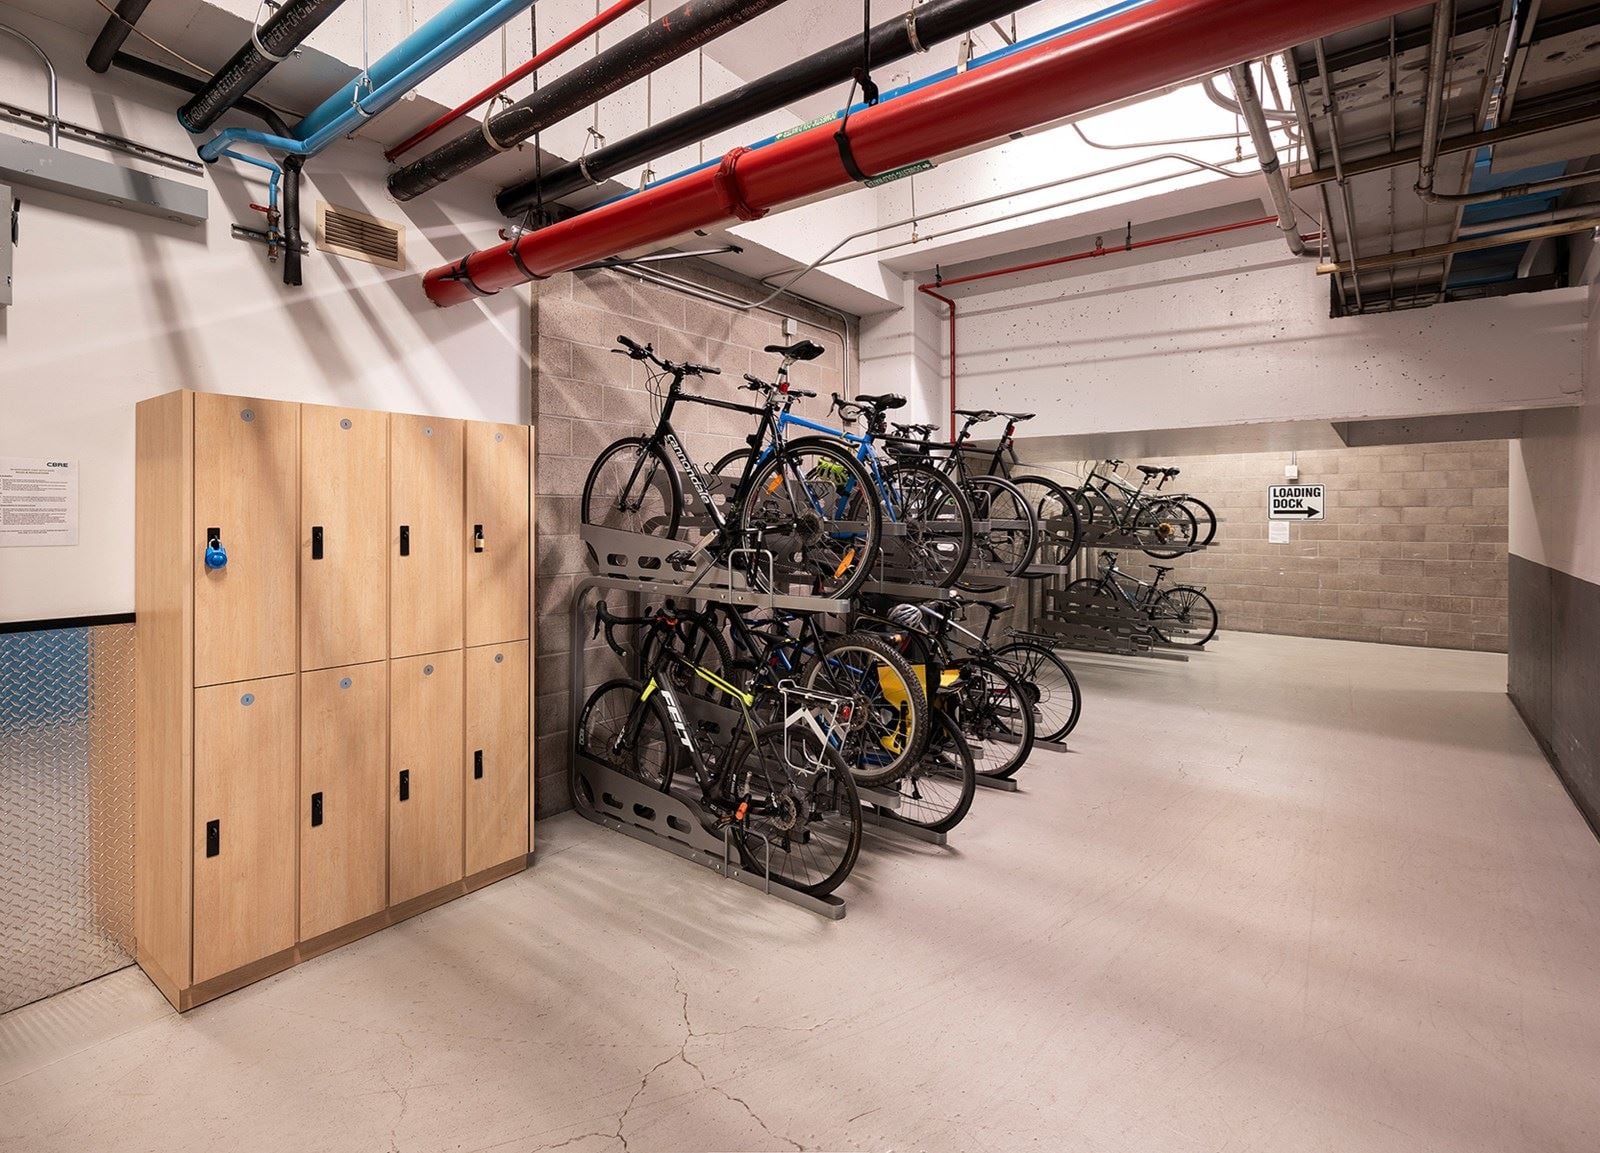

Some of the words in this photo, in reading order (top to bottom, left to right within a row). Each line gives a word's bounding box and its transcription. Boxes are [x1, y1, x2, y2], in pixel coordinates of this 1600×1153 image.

[666, 433, 710, 504] cannondale
[1273, 487, 1321, 498] LOADING
[1273, 498, 1303, 509] DOCK
[660, 690, 695, 752] FELT
